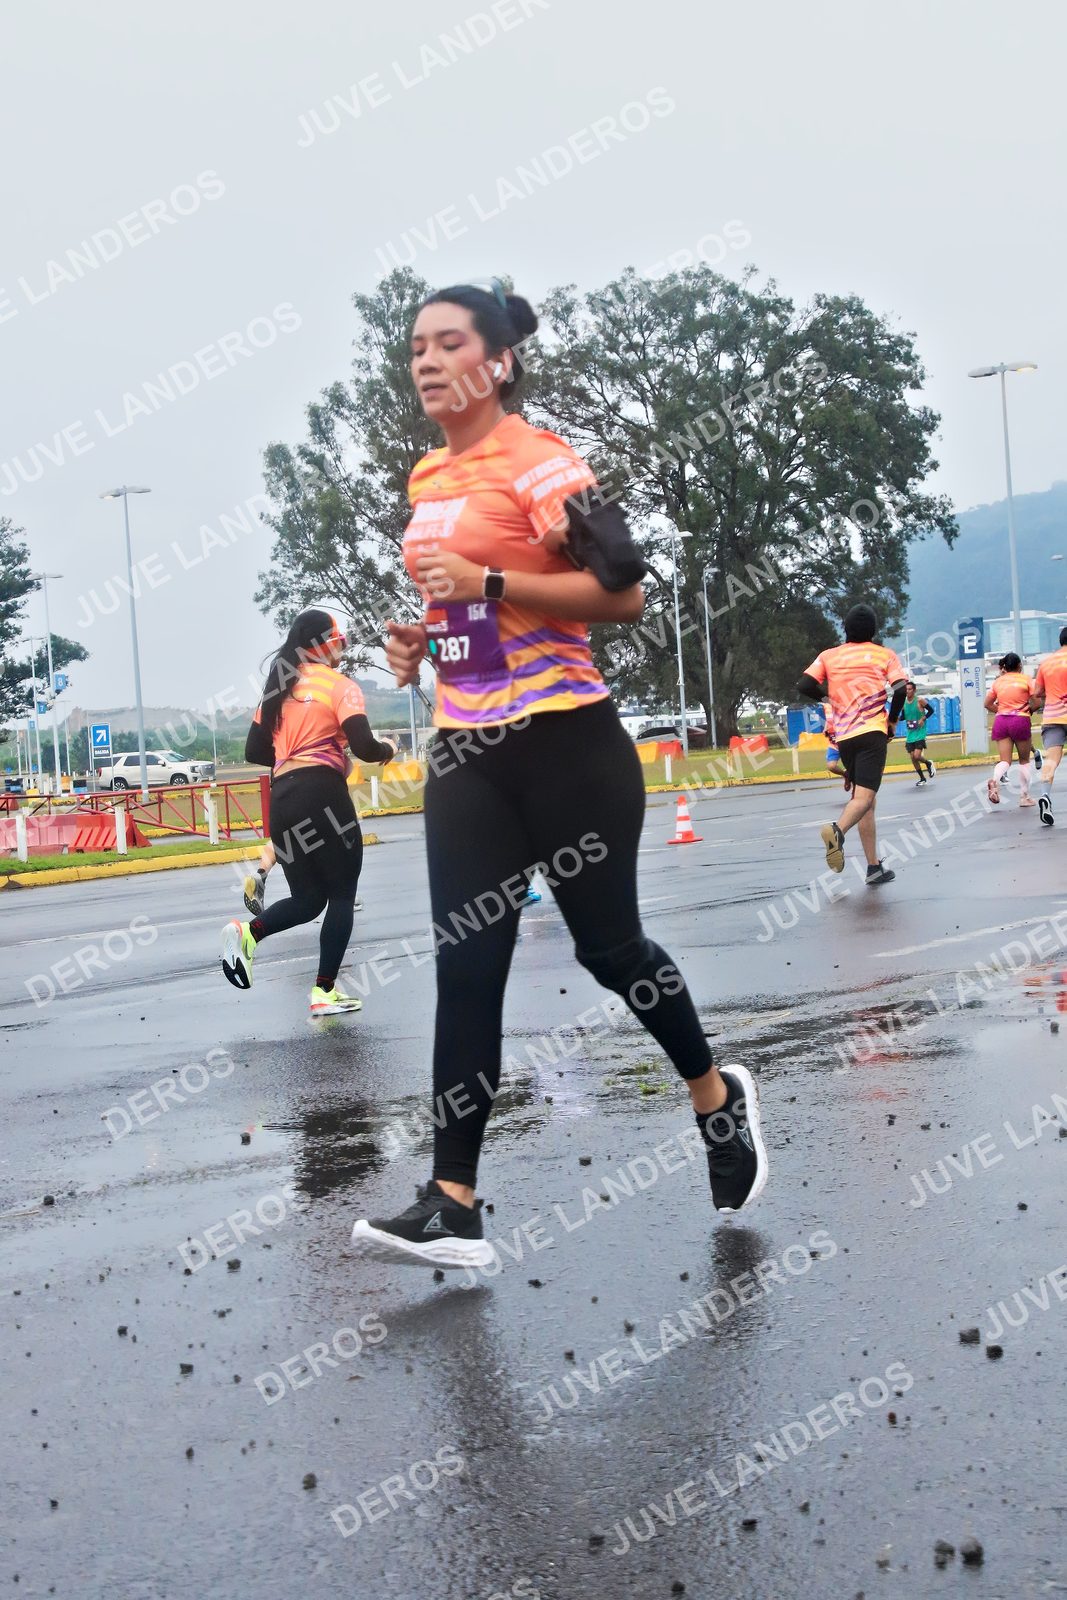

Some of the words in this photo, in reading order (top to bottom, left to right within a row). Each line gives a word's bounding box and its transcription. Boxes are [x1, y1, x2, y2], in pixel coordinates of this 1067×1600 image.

[467, 603, 488, 621] 15K
[437, 635, 470, 662] 287
[963, 635, 977, 654] E
